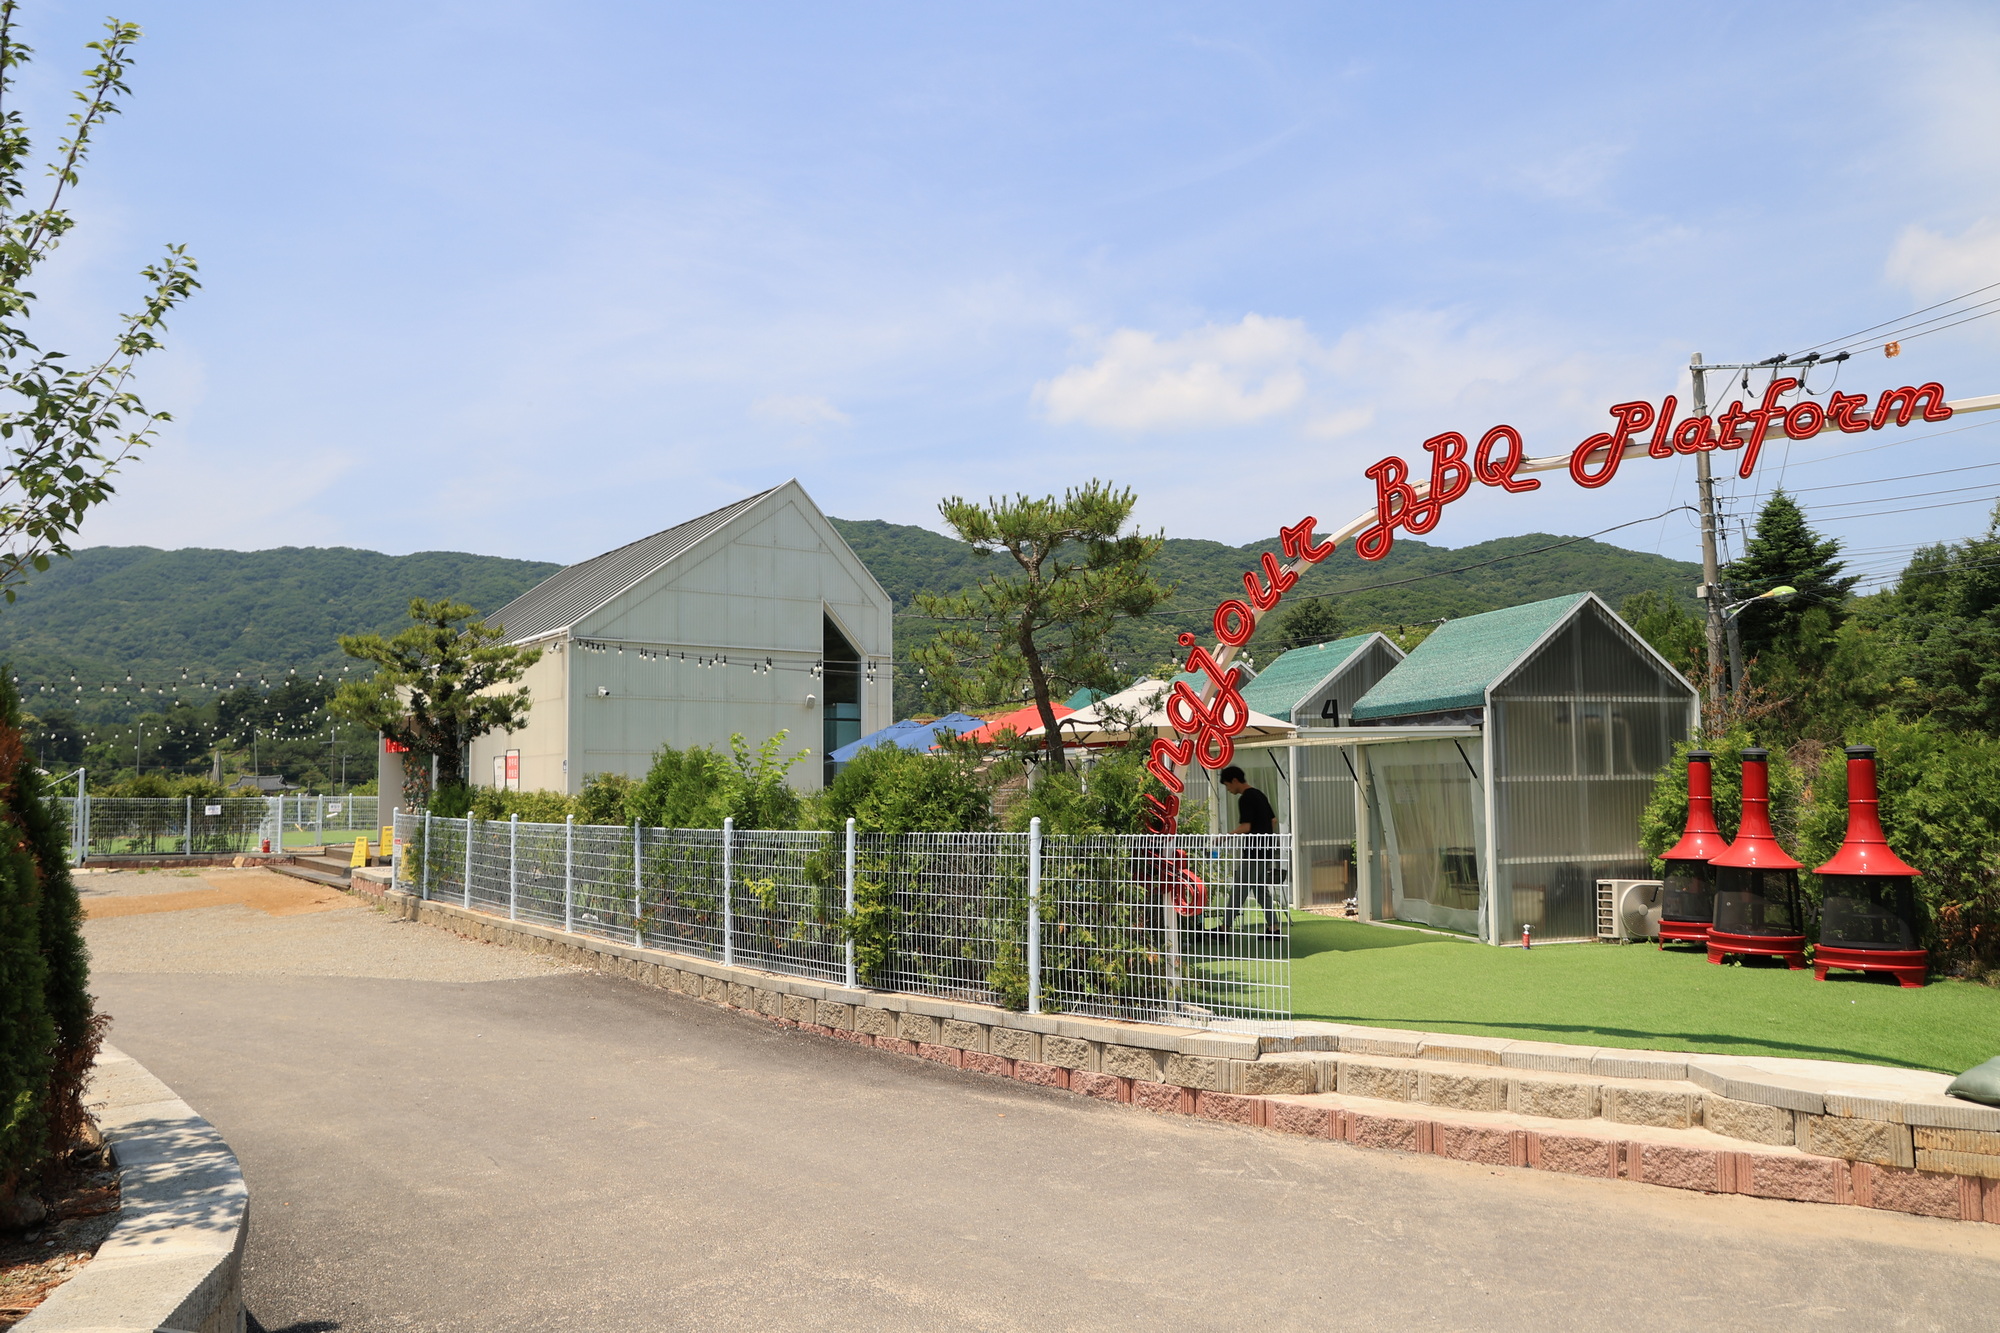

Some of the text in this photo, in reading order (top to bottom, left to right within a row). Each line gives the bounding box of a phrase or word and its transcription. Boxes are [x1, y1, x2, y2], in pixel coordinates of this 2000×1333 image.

[1356, 425, 1541, 562] BBQ
[1569, 378, 1953, 488] Platform
[1321, 699, 1339, 727] 4
